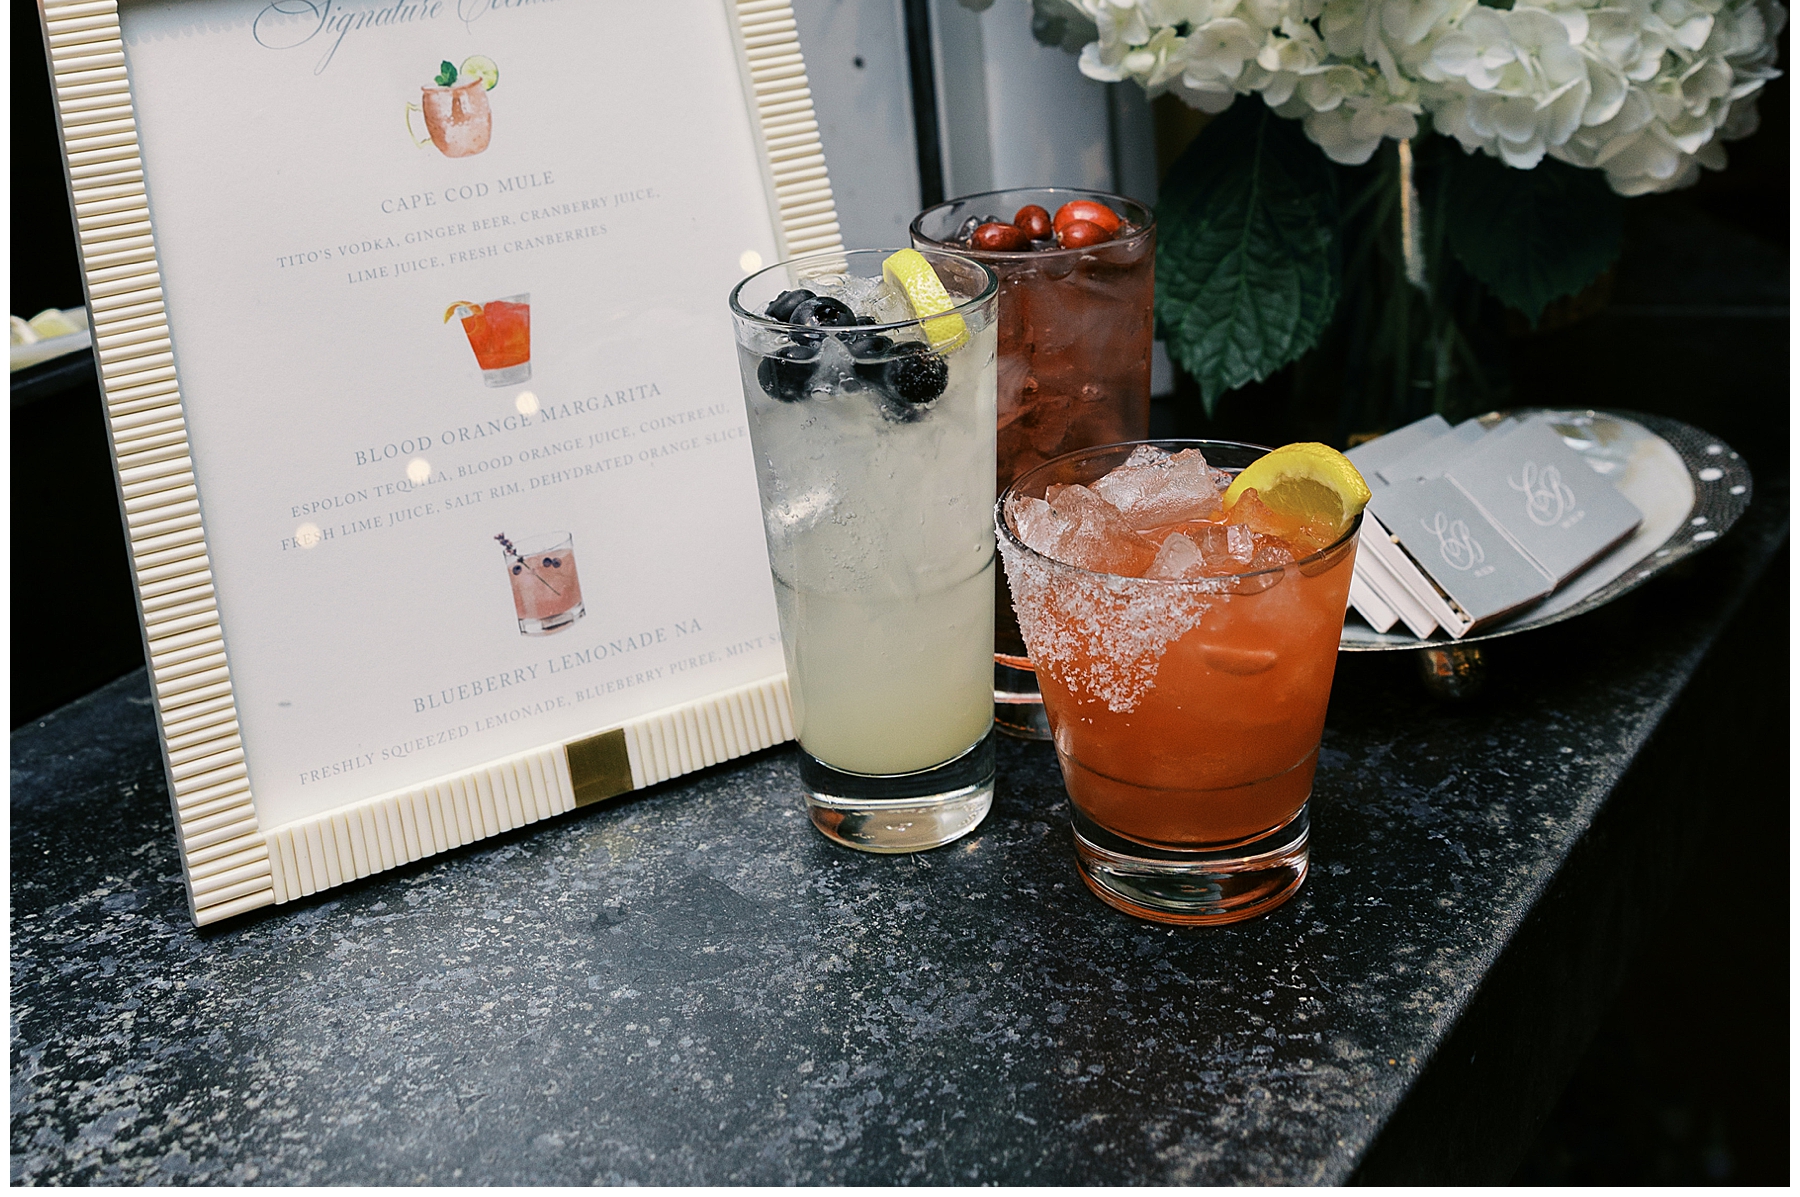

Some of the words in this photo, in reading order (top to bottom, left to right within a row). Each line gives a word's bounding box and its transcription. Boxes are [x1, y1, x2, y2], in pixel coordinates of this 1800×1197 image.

[277, 248, 333, 269] TITO'S
[338, 236, 401, 257] VODKA,
[404, 223, 467, 244] GINGER
[472, 215, 517, 232] BEER,
[520, 197, 610, 222] CRANBERRY
[612, 187, 661, 208] JUICE,
[381, 191, 436, 214] CAPE
[444, 181, 490, 202] COD
[498, 170, 556, 194] MULE
[347, 266, 389, 285] LIME
[394, 255, 445, 277] JUICE,
[449, 244, 499, 264] FRESH
[503, 224, 609, 254] CRANBERRIES
[291, 489, 369, 518] ESPOLON
[373, 470, 453, 498] TEQUILA,
[457, 457, 514, 479] BLOOD
[518, 439, 585, 464] ORANGE
[588, 427, 636, 449] JUICE,
[639, 403, 731, 434] COINTREAU,
[354, 435, 434, 466] BLOOD
[440, 412, 533, 447] ORANGE
[539, 382, 663, 424] MARGARITA
[281, 528, 336, 552] FRESH
[341, 516, 383, 537] LIME
[388, 504, 440, 527] JUICE,
[445, 491, 484, 510] SALT
[489, 482, 526, 500] RIM,
[529, 455, 635, 491] DEHYDRATED
[638, 439, 701, 462] ORANGE
[704, 426, 747, 445] SLICE
[412, 664, 539, 714] BLUEBERRY
[548, 628, 667, 675] LEMONADE
[674, 617, 703, 636] NA
[299, 753, 375, 786] FRESHLY
[381, 725, 469, 762] SQUEEZED
[474, 696, 573, 733] LEMONADE,
[575, 670, 664, 703] BLUEBERRY
[669, 650, 724, 675] PUREE,
[725, 639, 765, 659] MINT
